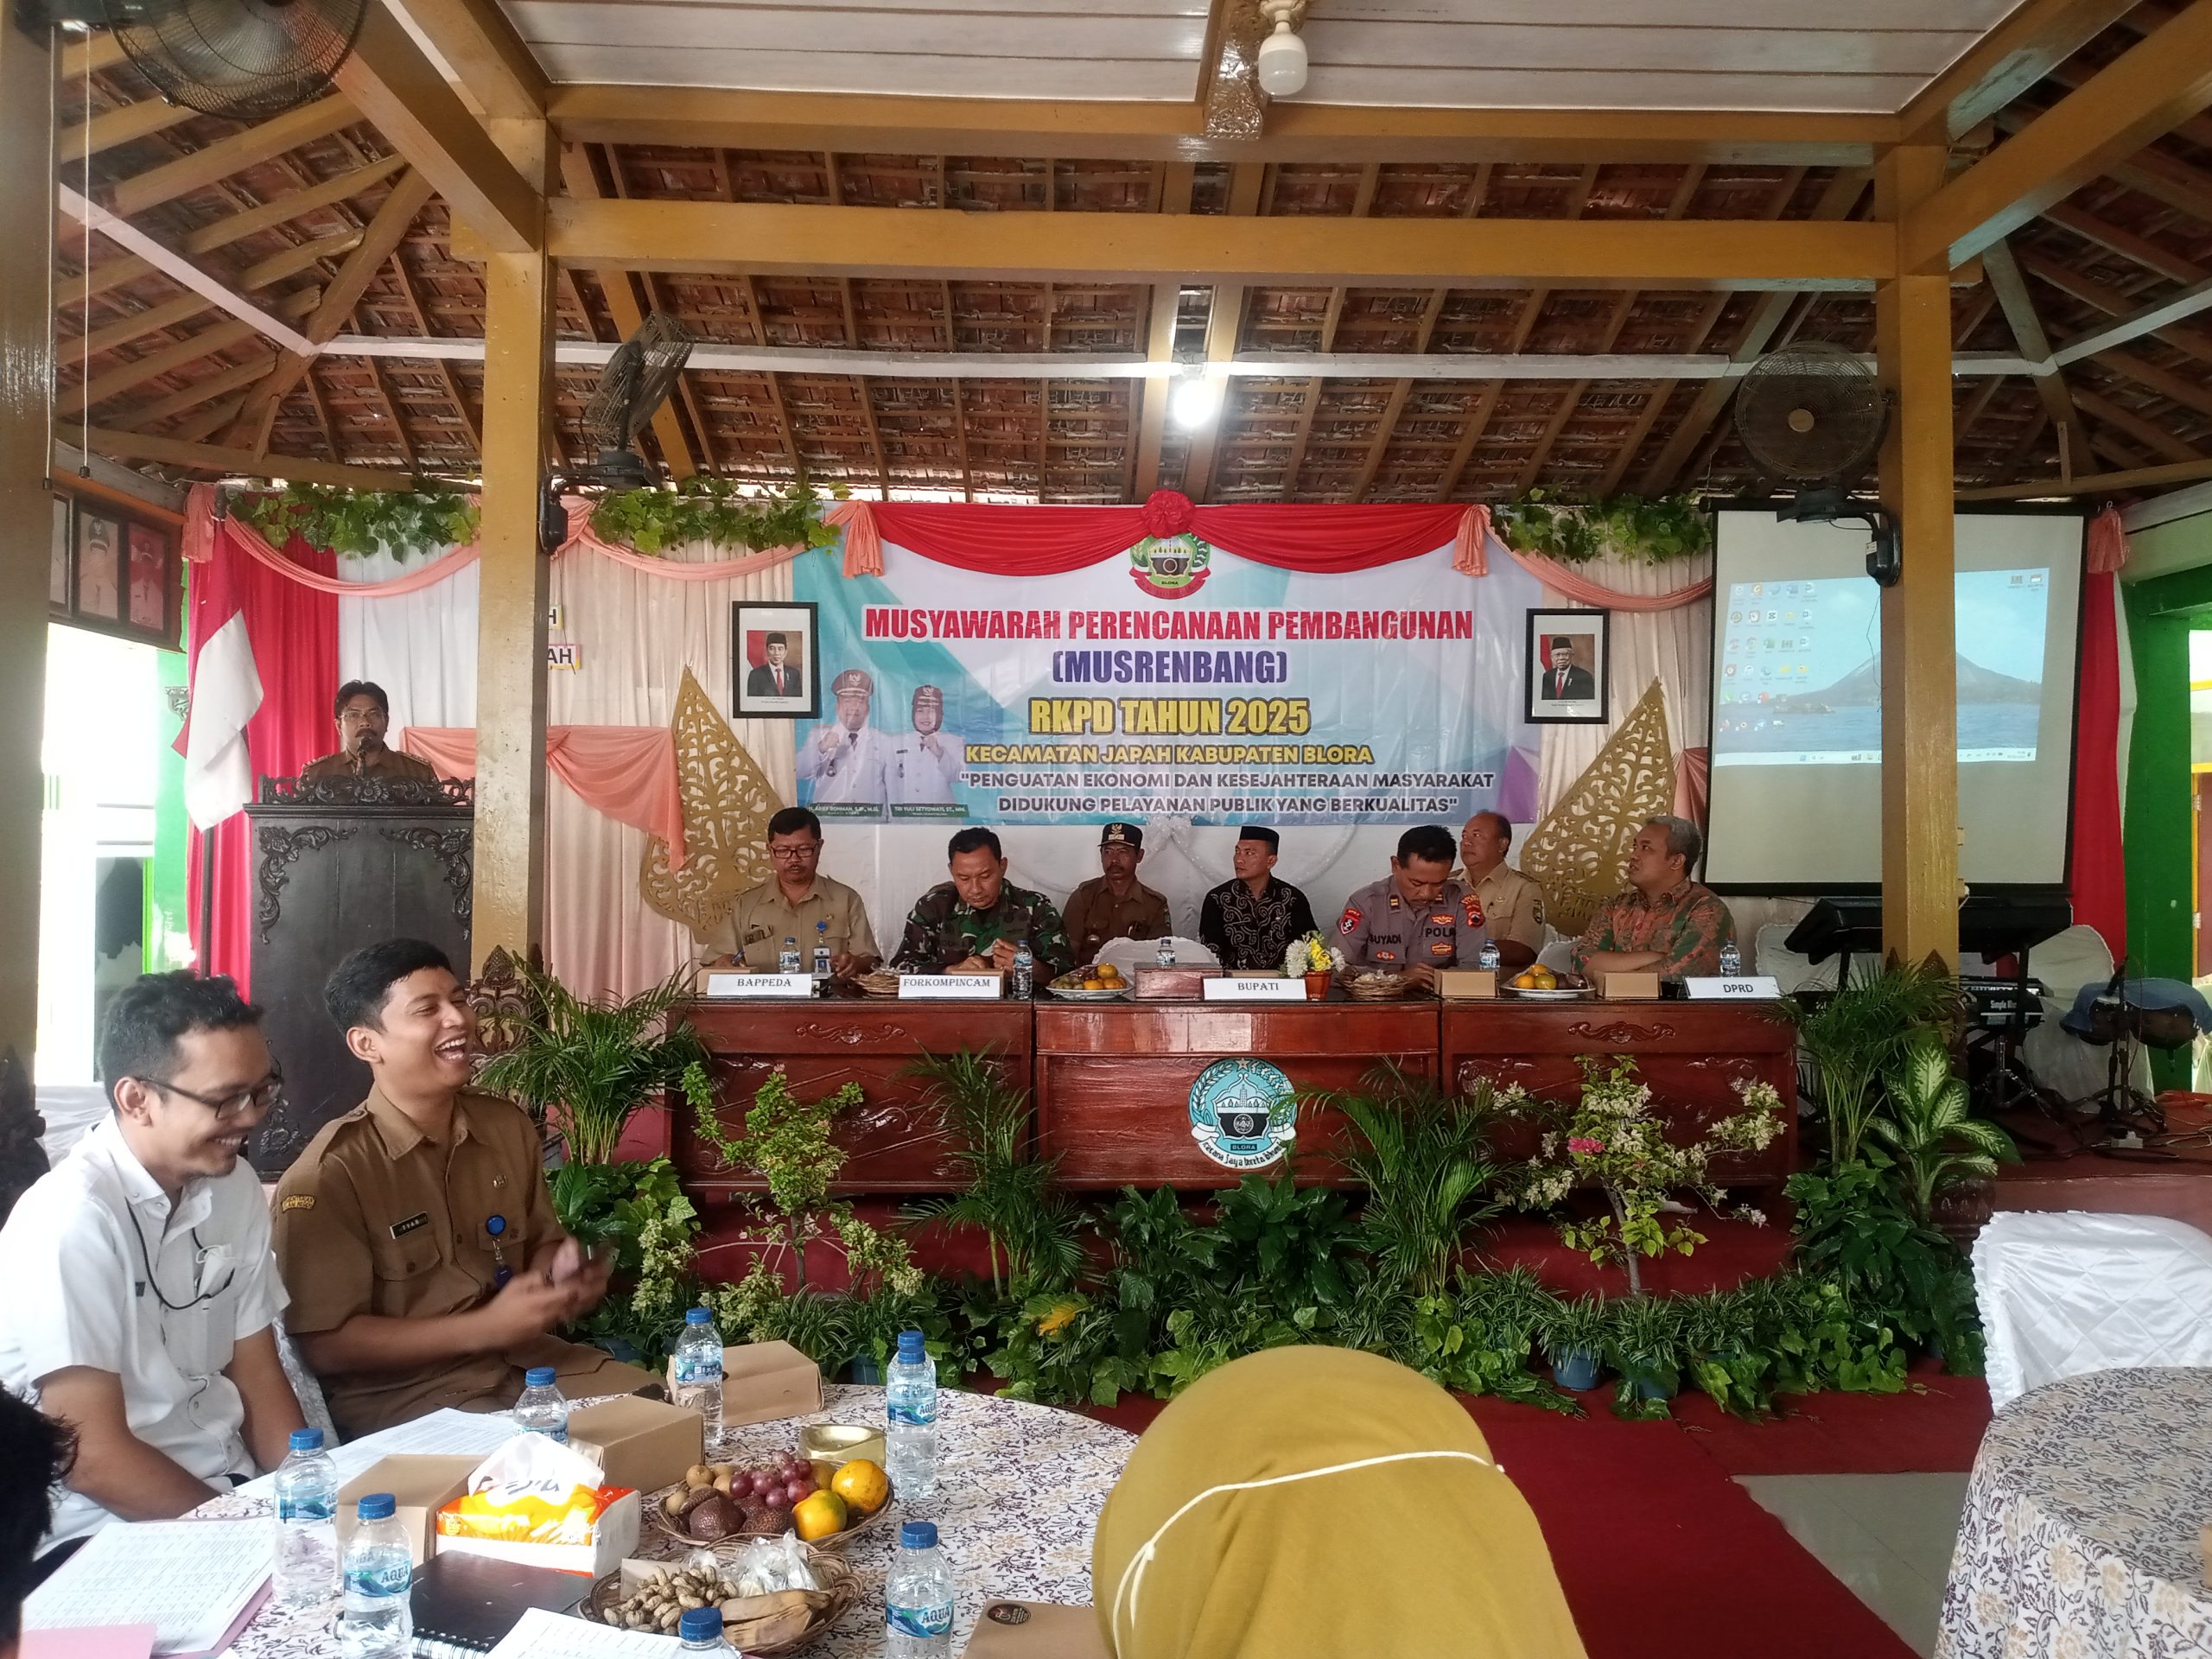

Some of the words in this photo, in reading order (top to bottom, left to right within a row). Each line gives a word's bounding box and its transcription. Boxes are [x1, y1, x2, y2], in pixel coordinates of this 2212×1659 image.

[865, 608, 1061, 639] MUSYAWARAH
[1068, 610, 1261, 639] PERENCANAAN
[1268, 610, 1473, 639] PEMBANGUNAN
[1052, 650, 1287, 683] (MUSRENBANG)
[1029, 698, 1115, 734] RKPD
[1121, 698, 1221, 735] TAHUN
[1226, 698, 1312, 735] 2025
[964, 745, 1098, 764] KECAMATAN
[1102, 746, 1171, 764] JAPAH
[1177, 746, 1297, 764] KABUPATEN
[1303, 746, 1375, 764] BLORA
[960, 772, 1079, 788] "PENGUATAN
[1084, 773, 1170, 787] EKONOMI
[1174, 773, 1212, 787] DAN
[1217, 773, 1369, 787] KESEJAHTERAAN
[1373, 773, 1494, 787] MASYARAKAT
[998, 798, 1096, 811] DIDUKUNG
[1100, 798, 1205, 811] PELAYANAN
[1210, 798, 1273, 811] PUBLIK
[1275, 798, 1326, 811] YANG
[1331, 798, 1458, 812] BERKUALITAS"
[737, 978, 791, 987] BAPPEDA
[903, 978, 991, 988] FORKOMPINCAM
[1237, 982, 1280, 992] BUPATI
[1722, 983, 1754, 994] DPRD
[381, 1565, 409, 1583] AQUA
[921, 1605, 950, 1624] AQUA
